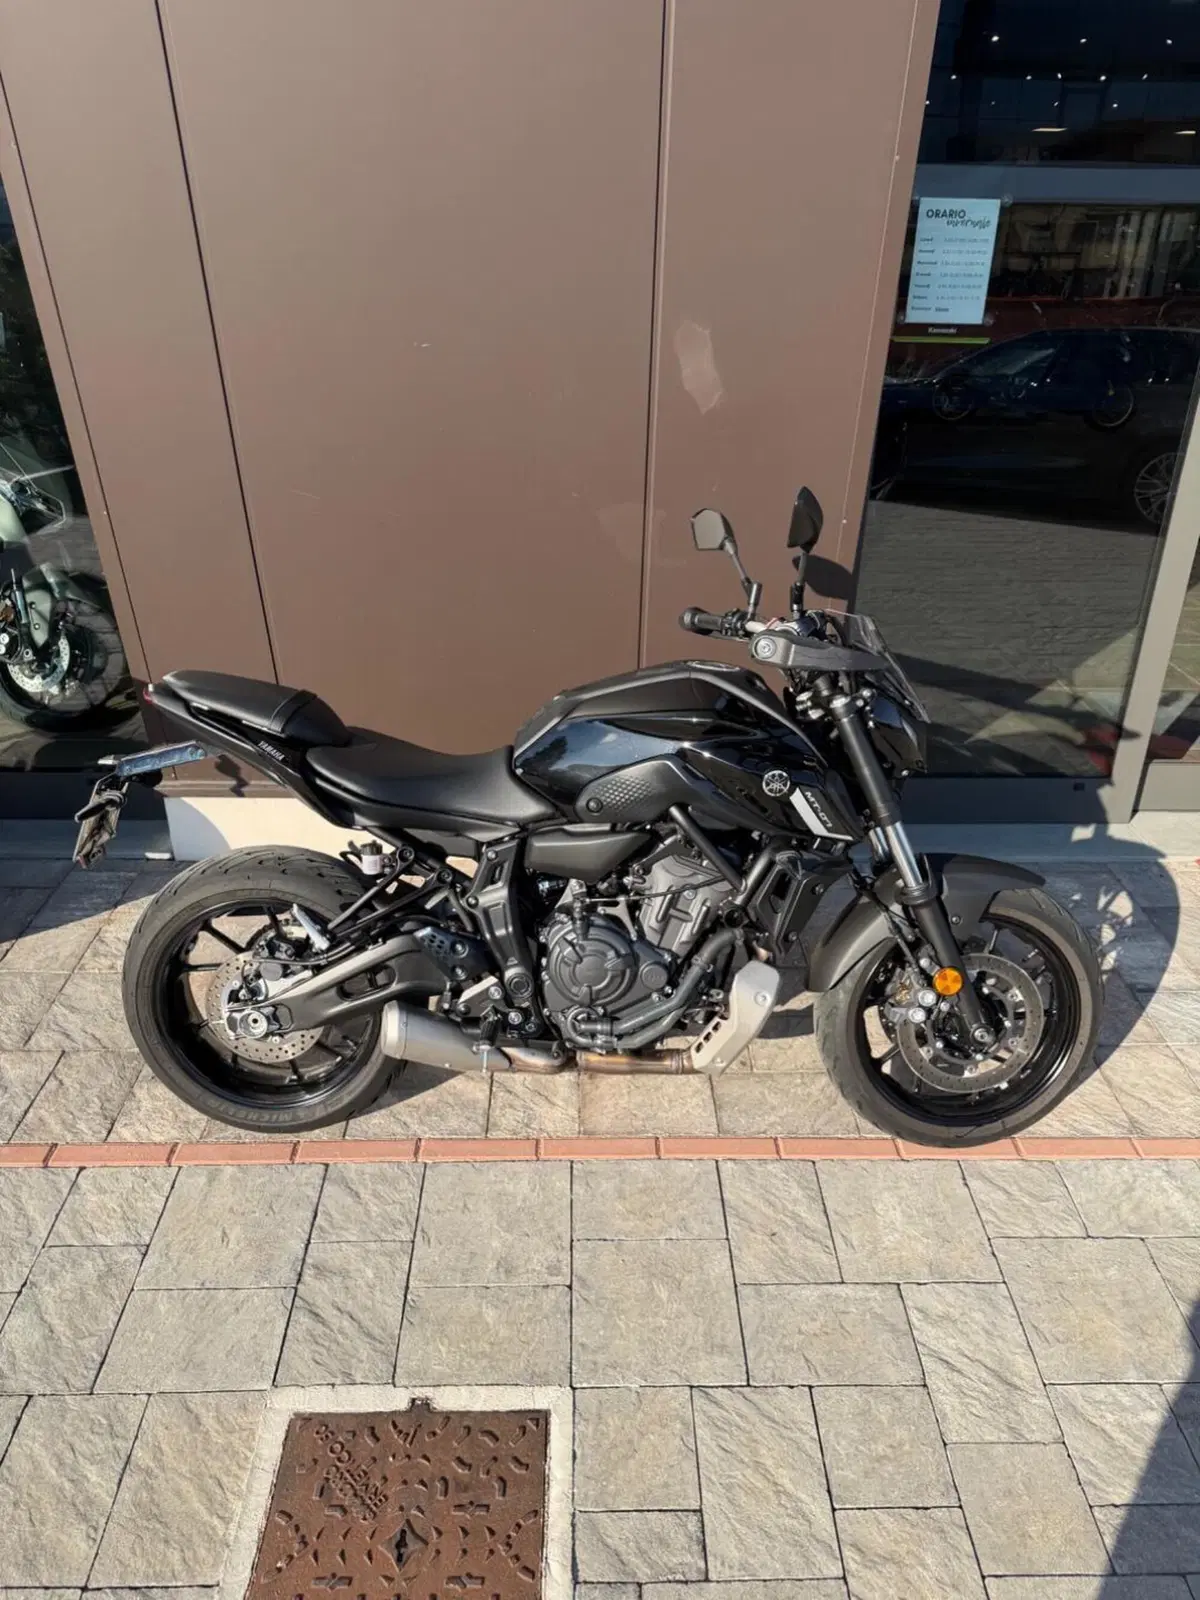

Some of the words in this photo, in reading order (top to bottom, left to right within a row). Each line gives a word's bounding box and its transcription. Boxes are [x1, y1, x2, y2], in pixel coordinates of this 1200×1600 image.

[926, 209, 967, 219] ORARIO
[258, 740, 285, 761] YAMAHA
[805, 791, 833, 828] MT-07
